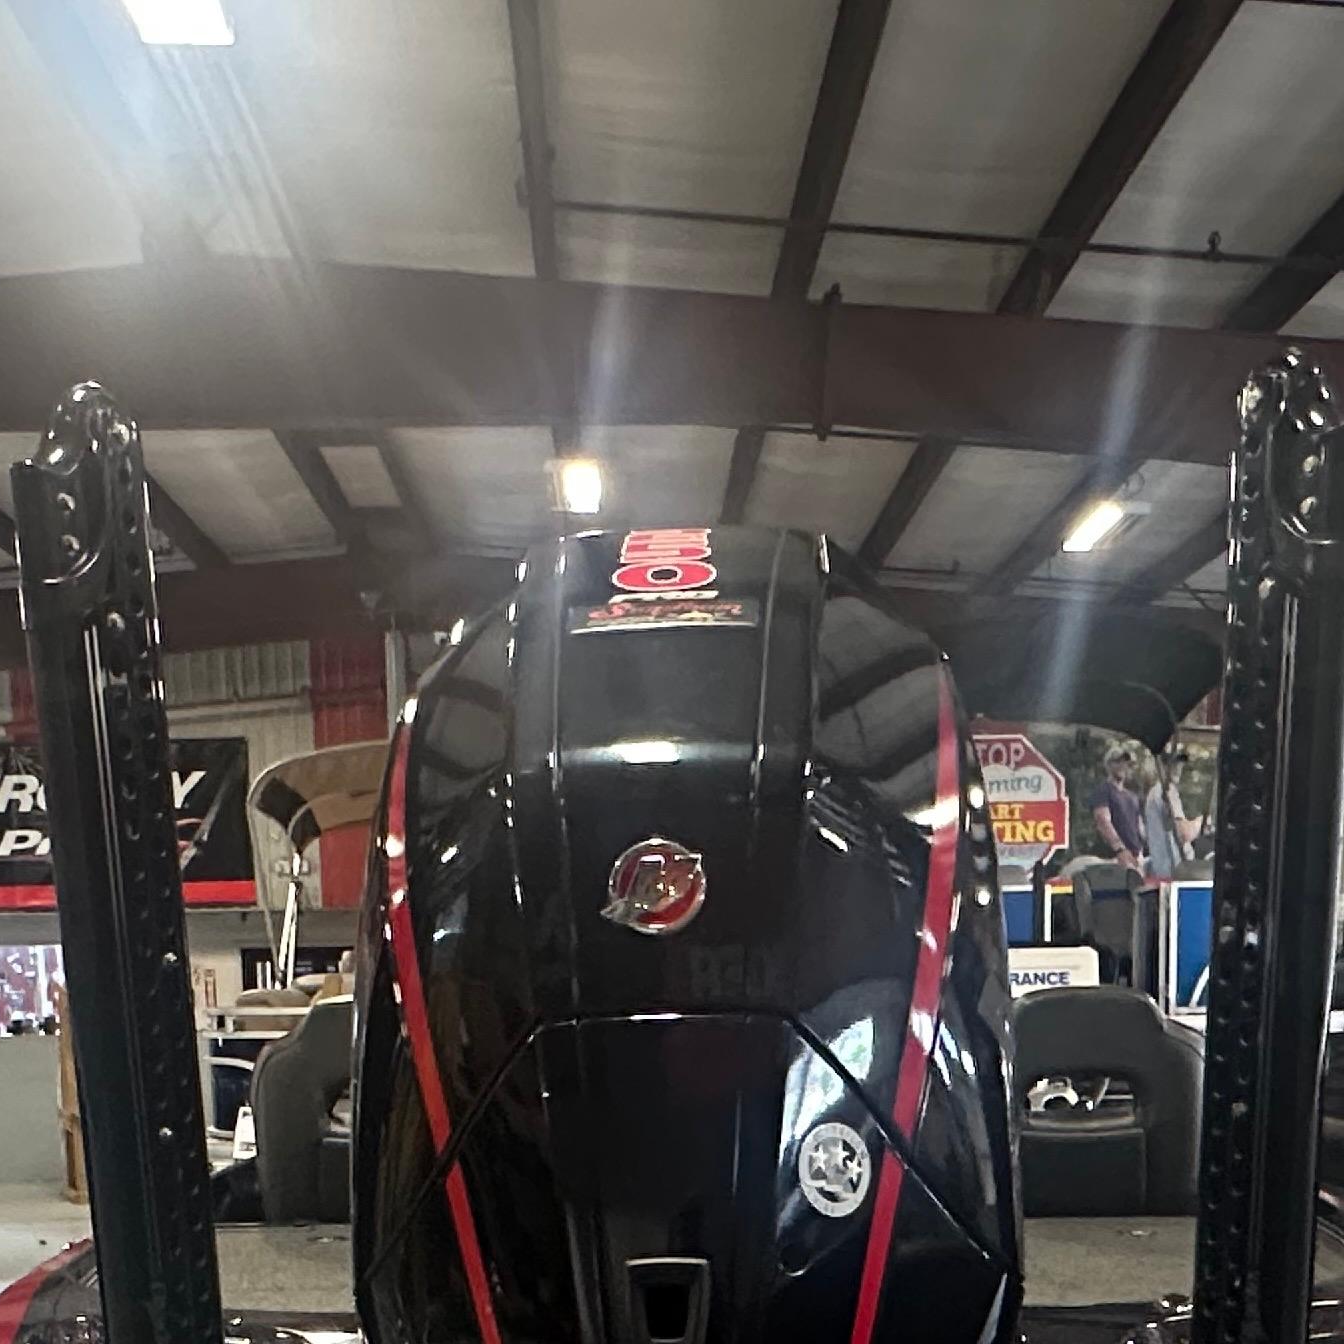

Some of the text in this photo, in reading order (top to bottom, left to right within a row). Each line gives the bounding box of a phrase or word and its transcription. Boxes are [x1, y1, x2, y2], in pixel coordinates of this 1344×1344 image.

[975, 742, 1025, 769] TOP
[993, 821, 1055, 842] TING
[1010, 971, 1070, 985] RANCE
